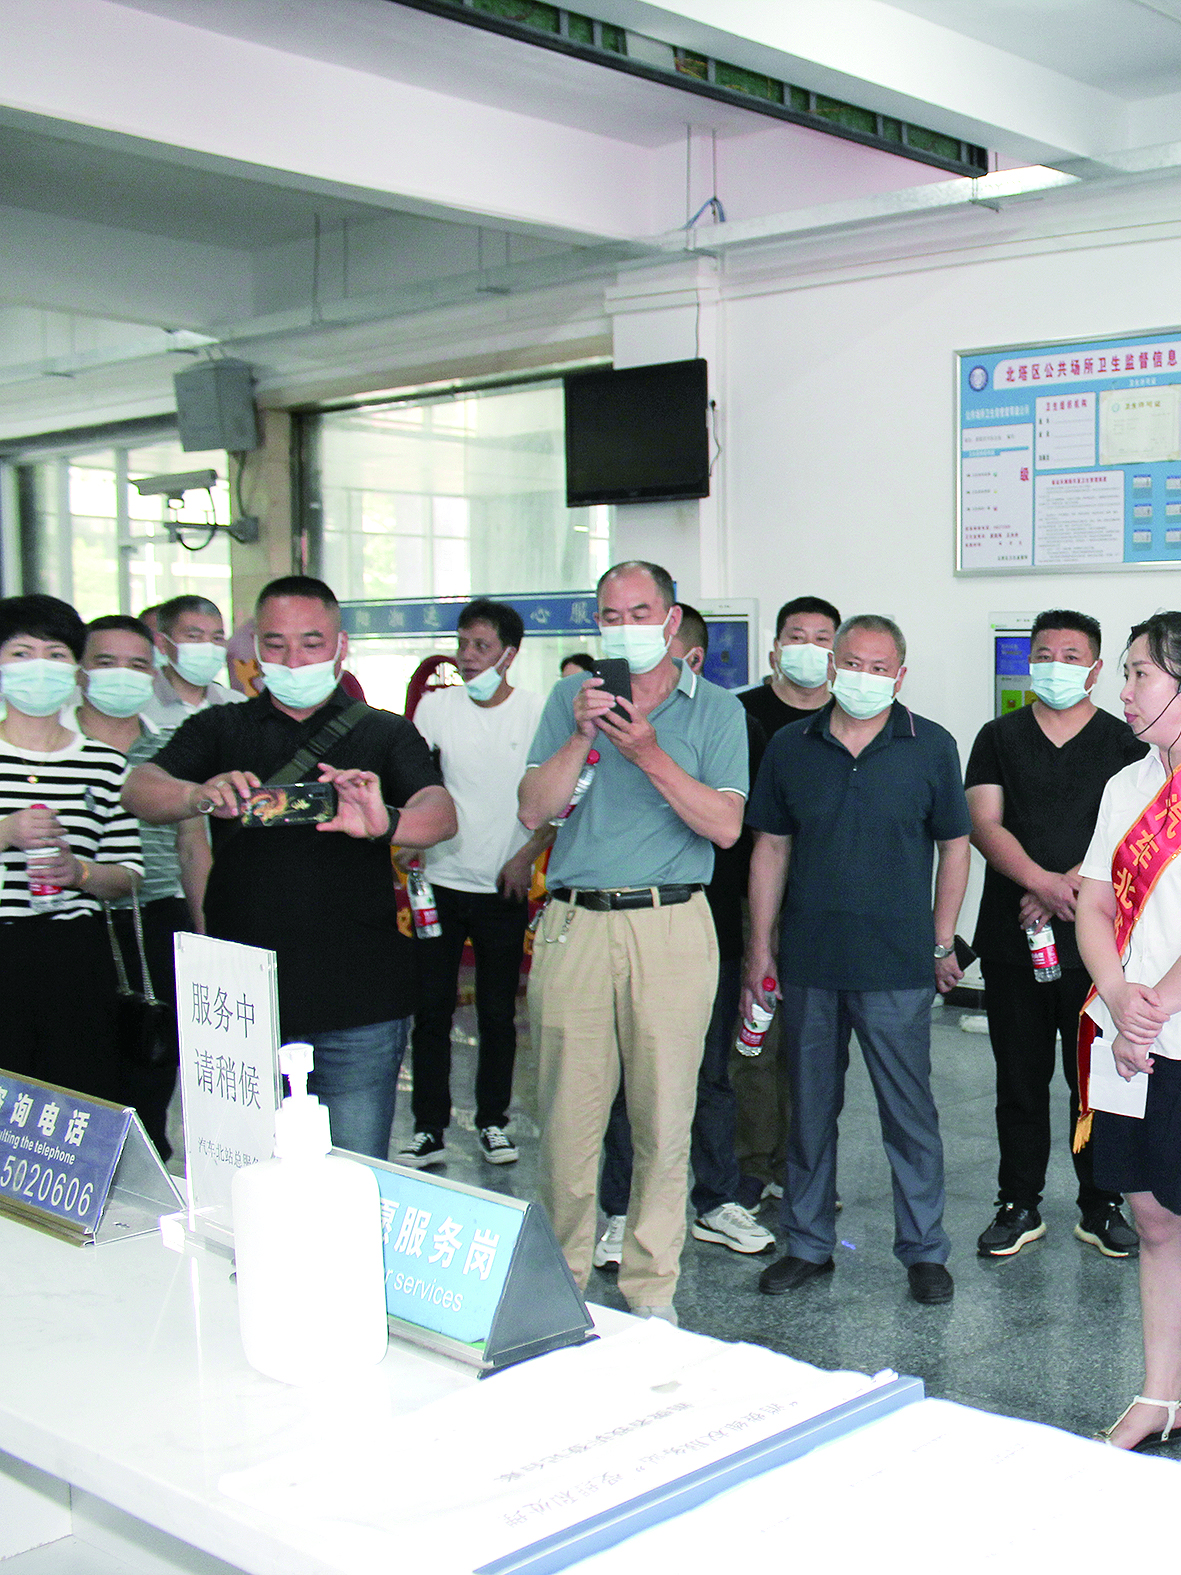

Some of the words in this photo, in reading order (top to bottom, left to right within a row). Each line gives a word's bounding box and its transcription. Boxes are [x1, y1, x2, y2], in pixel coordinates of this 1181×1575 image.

[191, 981, 255, 1039] 服务中
[194, 1048, 261, 1110] 请稍候
[20, 1135, 33, 1151] the
[34, 1140, 76, 1165] telephone
[0, 1155, 94, 1217] 5020606
[393, 1272, 464, 1312] services
